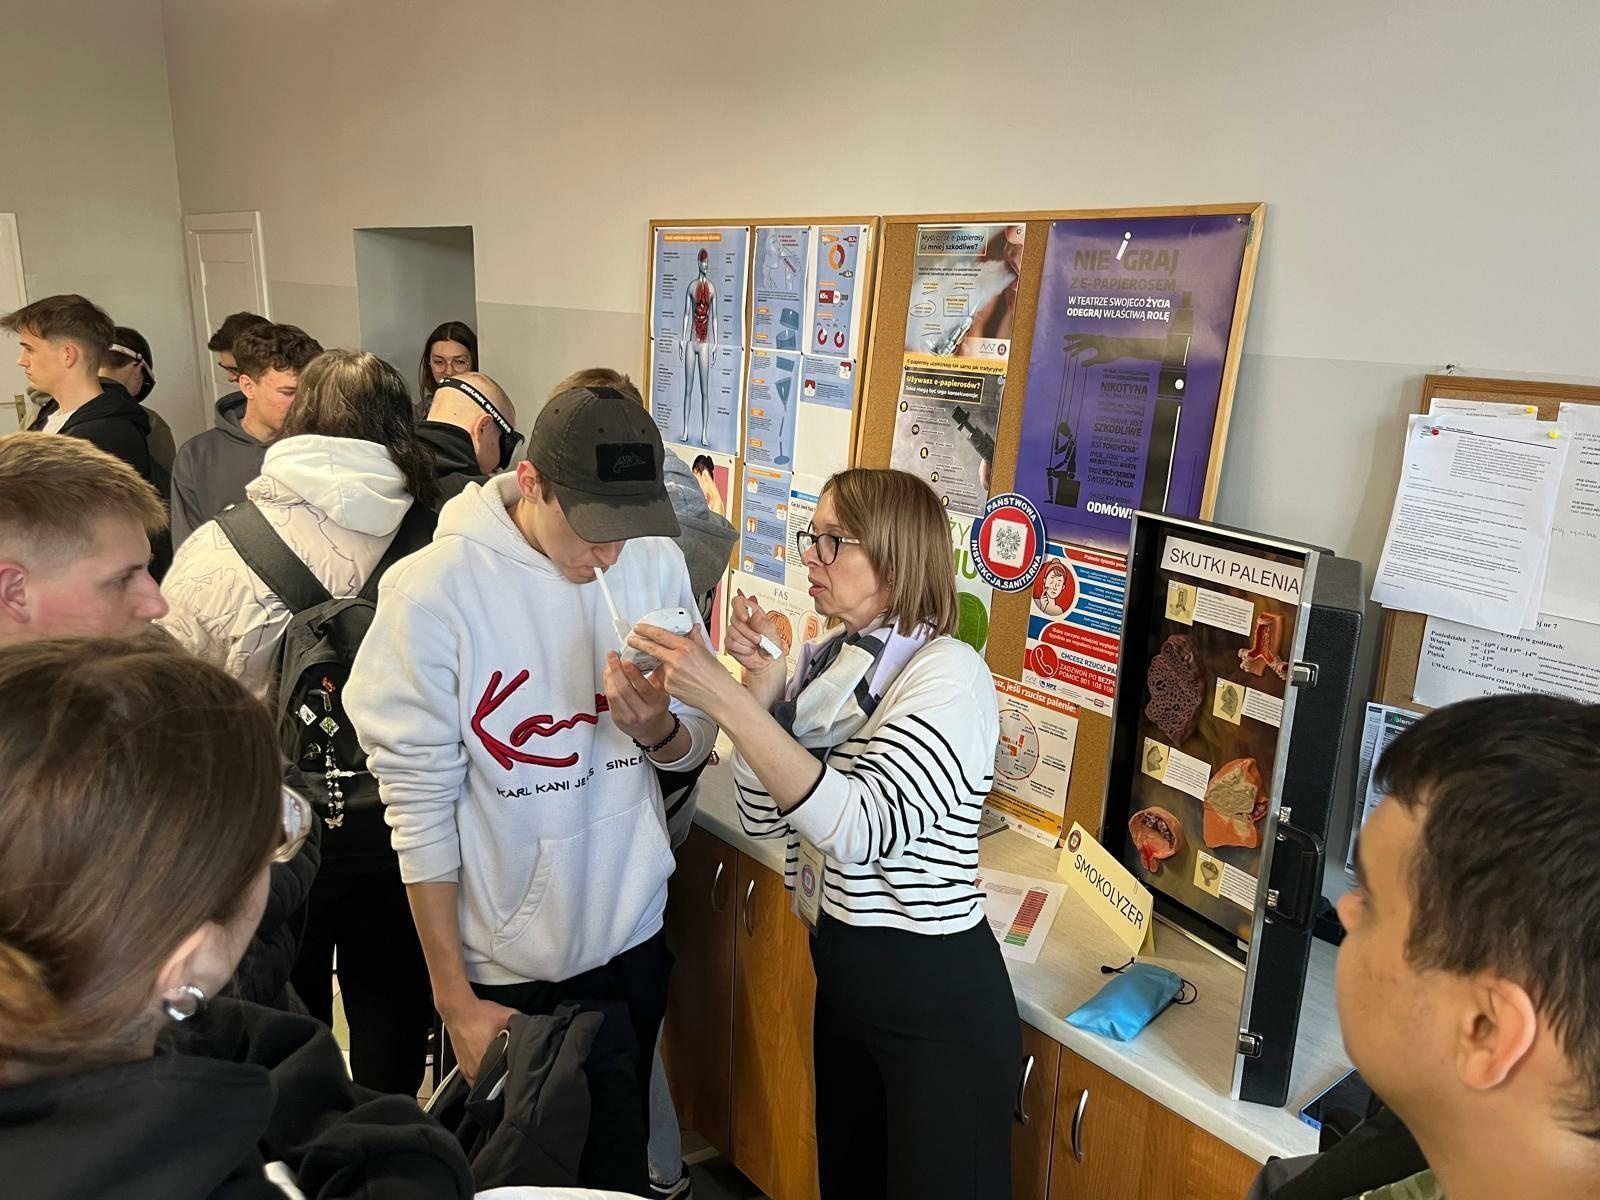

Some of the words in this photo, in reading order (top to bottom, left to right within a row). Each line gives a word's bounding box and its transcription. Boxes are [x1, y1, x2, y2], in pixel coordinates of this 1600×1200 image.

[951, 234, 984, 242] e-papierosy
[1074, 250, 1111, 270] NIE
[1122, 249, 1180, 276] GRAJ
[1068, 296, 1077, 304] W
[1077, 296, 1109, 306] TEATRZE
[1109, 297, 1144, 308] SWOJEGO
[1145, 296, 1170, 308] ŻYCIA
[1066, 308, 1102, 319] ODEGRAJ
[1103, 308, 1147, 322] WŁAŚCIWĄ
[1147, 311, 1170, 322] ROLĘ
[906, 375, 933, 385] Używasz
[934, 379, 980, 389] e-papierosów?
[1101, 382, 1147, 395] NIKOTYNA
[460, 384, 486, 405] DRUNK
[485, 404, 512, 433] BUSTERS
[1093, 423, 1142, 437] SZKODLIWE
[1115, 478, 1134, 488] ŻYCIA
[986, 496, 1037, 522] PAŃSTWOWA
[1087, 501, 1133, 519] ODMÓW!
[971, 540, 1001, 588] INSPEKCJA
[1003, 556, 1041, 588] SANITARNA
[1170, 548, 1225, 575] SKUTKI
[1230, 562, 1299, 594] PALENIA
[774, 588, 789, 601] FAS
[1430, 637, 1451, 646] Wtorek
[1431, 630, 1467, 643] Poniedziałek
[1532, 639, 1565, 650] godzinach:
[1061, 652, 1083, 664] CHCESZ
[1085, 660, 1106, 671] RZUCIĆ
[1431, 662, 1456, 672] UWAGA:
[1060, 664, 1088, 678] ZADZWOŃ
[1046, 682, 1057, 690] NPZ
[1059, 670, 1080, 682] POMOC
[1080, 677, 1090, 685] 801
[1092, 681, 1102, 690] 108
[1103, 684, 1113, 693] 108
[1006, 681, 1020, 694] jeśli
[1021, 688, 1046, 703] rzucisz
[1047, 696, 1076, 713] palenie:
[496, 787, 532, 798] KARL
[536, 780, 570, 794] KANI
[606, 755, 644, 770] SINCE
[1074, 854, 1144, 930] SMOKOLYZER
